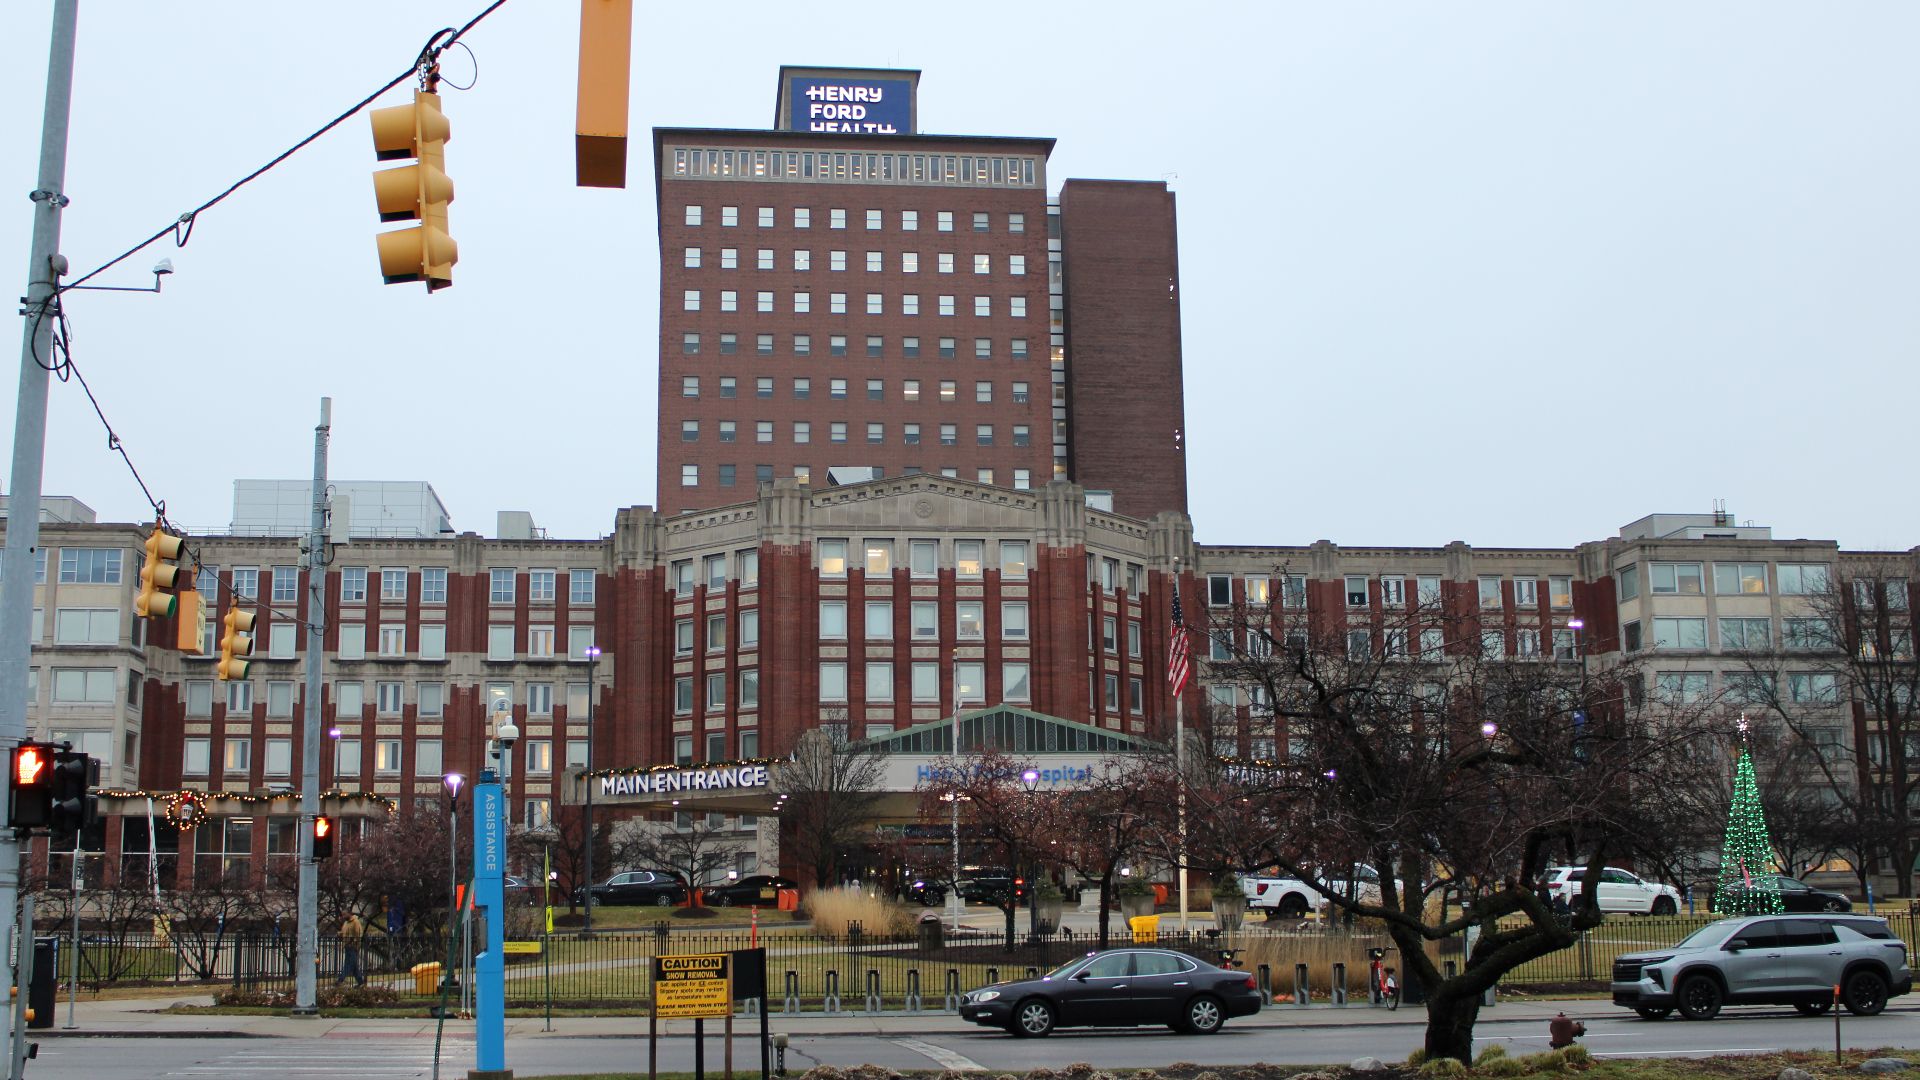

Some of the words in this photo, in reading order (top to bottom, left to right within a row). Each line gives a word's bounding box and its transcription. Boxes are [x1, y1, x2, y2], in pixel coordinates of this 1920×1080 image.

[806, 86, 882, 102] HENRY
[810, 104, 866, 120] FORD
[601, 775, 649, 795] MAIN
[655, 766, 766, 792] ENTRANCE
[486, 793, 496, 871] ASSISTANCE
[664, 958, 720, 969] CAUTION
[666, 972, 685, 980] SNOW
[687, 971, 718, 979] REMOVAL
